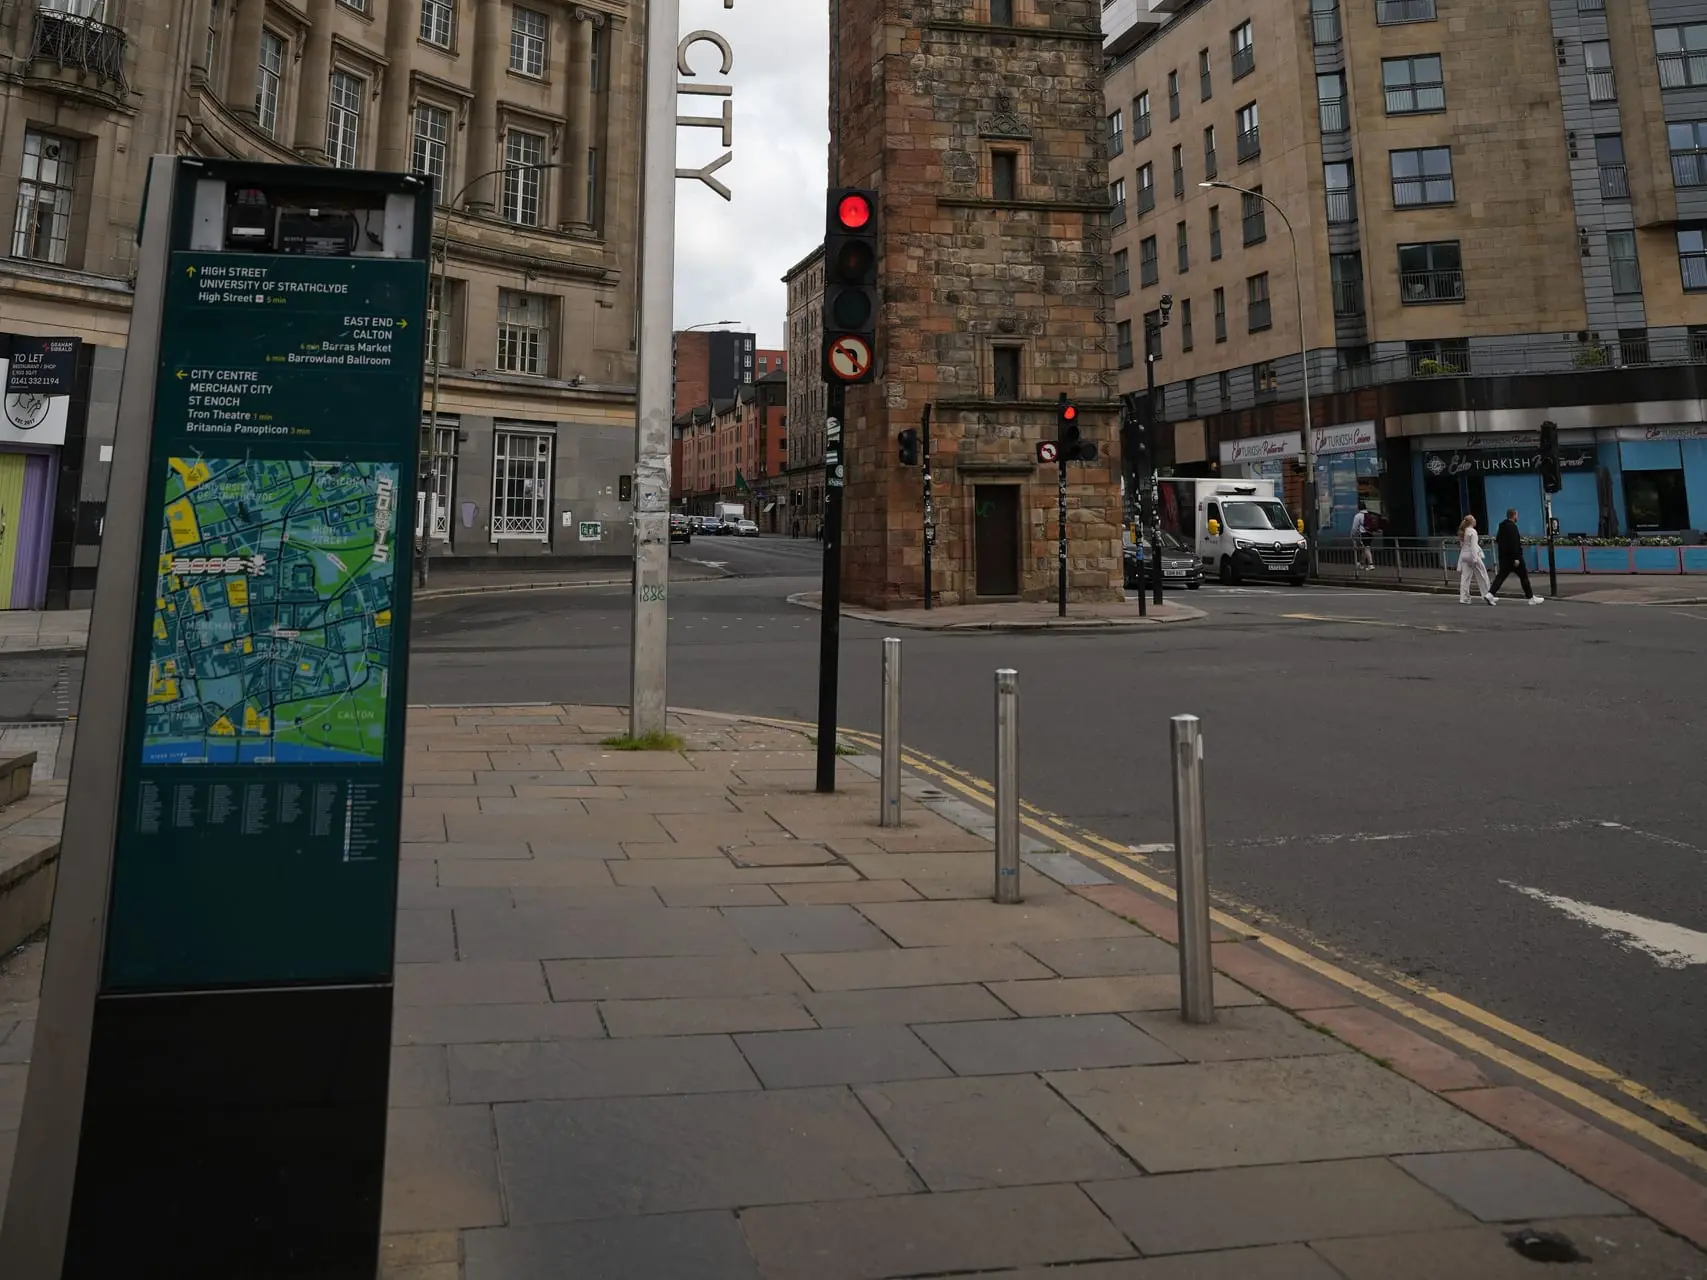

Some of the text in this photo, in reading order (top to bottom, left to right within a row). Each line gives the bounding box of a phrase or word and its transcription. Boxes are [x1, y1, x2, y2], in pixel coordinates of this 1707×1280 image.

[675, 29, 734, 203] CITY
[201, 266, 267, 278] HIGH STREET
[200, 279, 348, 294] UNIVERSITY OF STRATHCLYDE
[199, 292, 221, 304] High
[223, 293, 253, 303] Street
[272, 296, 287, 304] min
[344, 317, 393, 327] EAST END
[353, 329, 393, 340] CALTON
[322, 341, 355, 352] Barras
[358, 343, 391, 353] Market
[14, 353, 44, 363] TO LET
[288, 353, 344, 364] Barrowland
[347, 354, 391, 365] Ballroom
[10, 377, 60, 385] 0141 332 1194
[191, 370, 258, 381] CITY CENTRE
[190, 383, 273, 395] MERCHANT CITY
[188, 396, 240, 406] ST ENOCH
[187, 409, 210, 419] Tron
[213, 410, 251, 420] Theatre
[186, 422, 232, 433] Britannia
[234, 423, 289, 436] Panopticon
[1327, 434, 1353, 447] TURKISH
[1242, 445, 1261, 457] TURKISH
[1474, 458, 1530, 471] TURKISH
